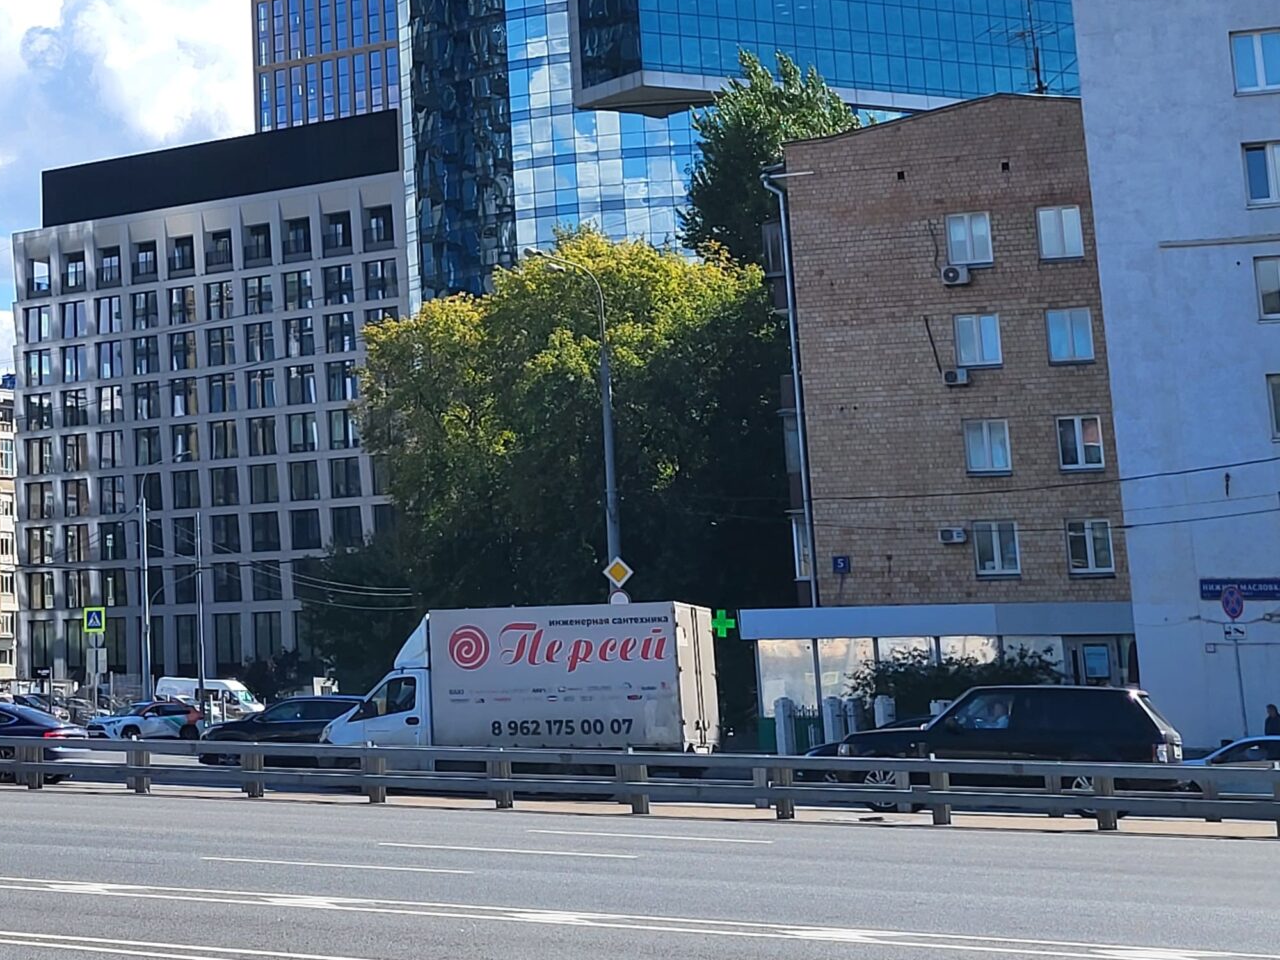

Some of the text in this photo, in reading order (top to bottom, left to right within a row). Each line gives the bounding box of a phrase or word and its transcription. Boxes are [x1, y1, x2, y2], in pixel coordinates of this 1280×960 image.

[837, 558, 844, 568] 5
[548, 615, 669, 628] инженерная сантехника
[498, 622, 671, 673] Персей
[491, 718, 634, 736] 8 962 175 00 07
